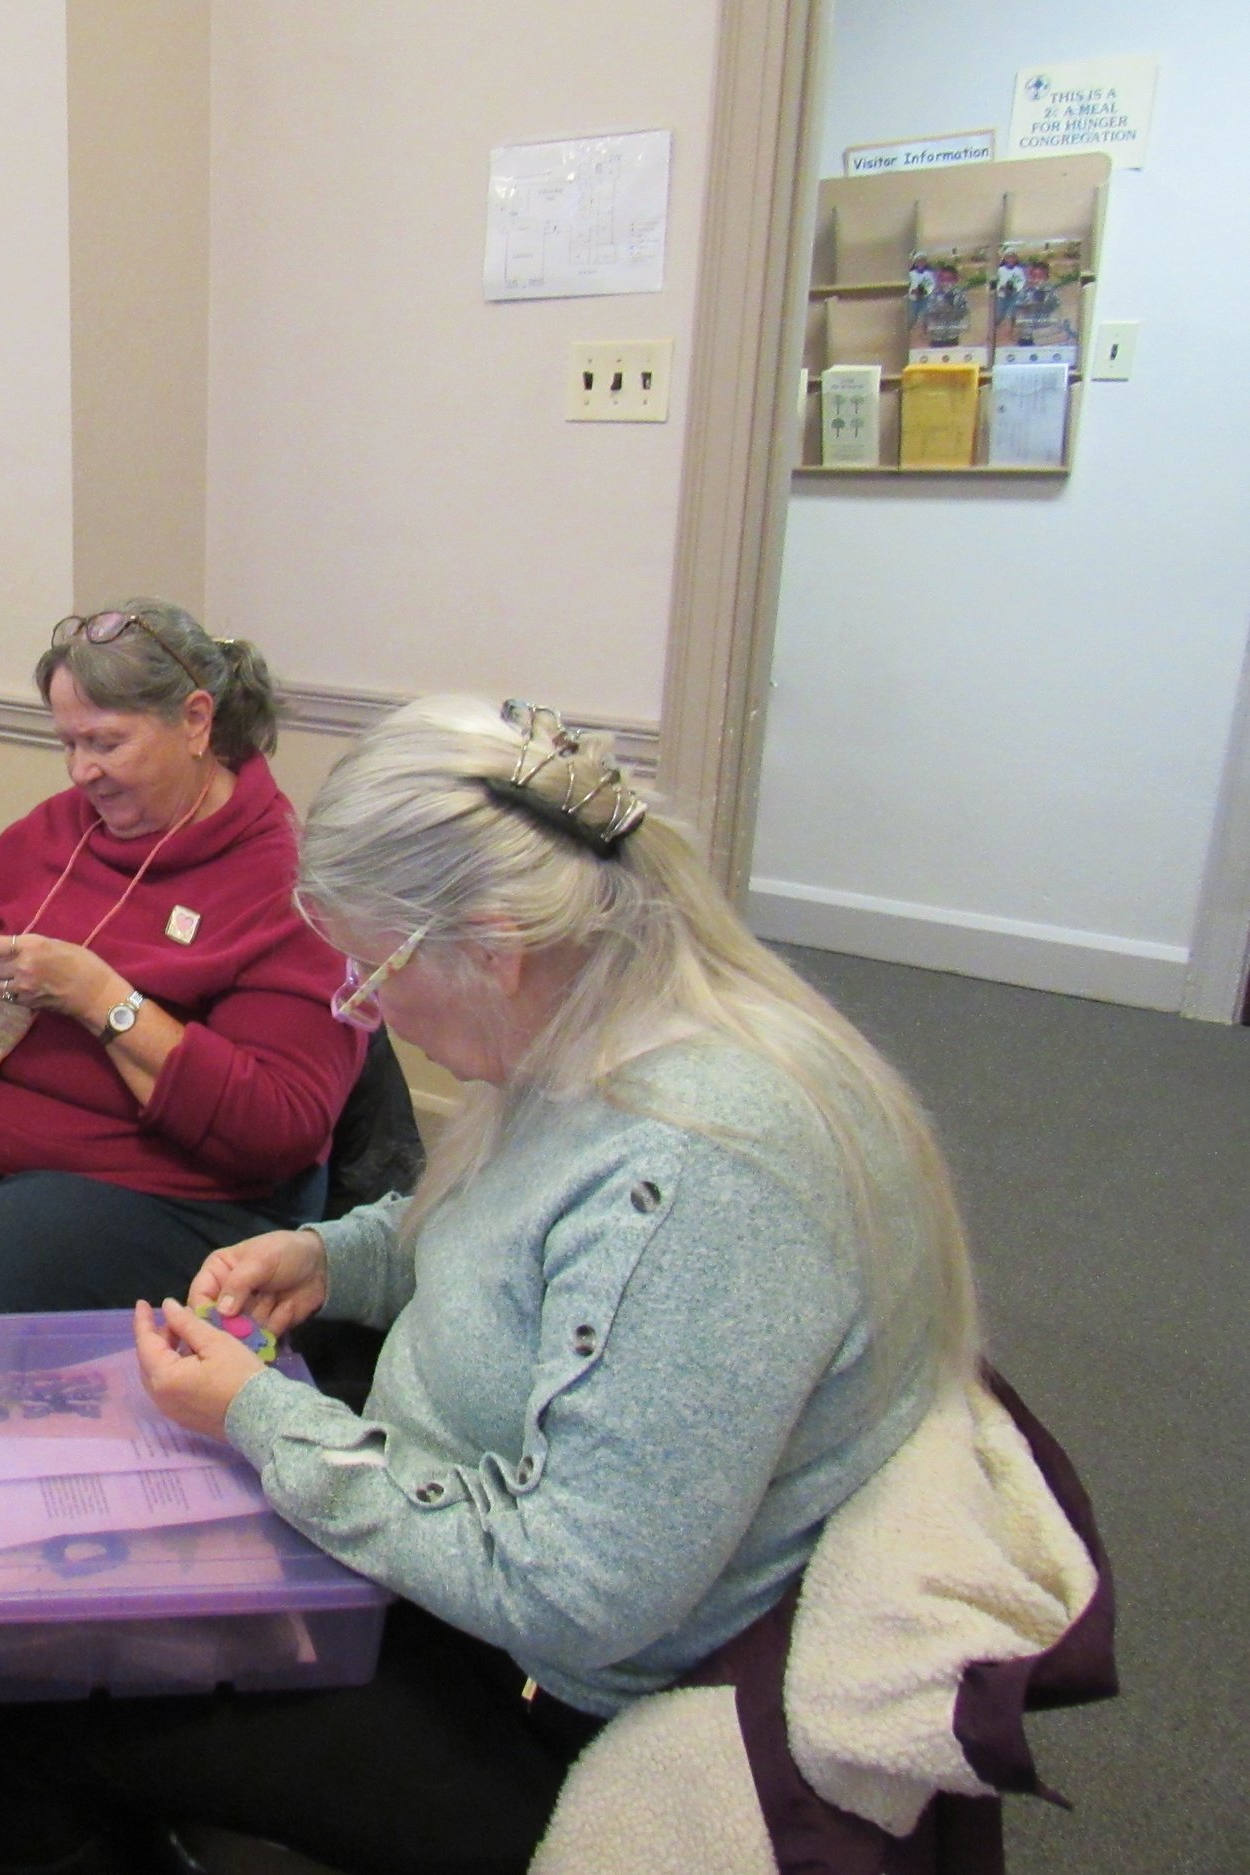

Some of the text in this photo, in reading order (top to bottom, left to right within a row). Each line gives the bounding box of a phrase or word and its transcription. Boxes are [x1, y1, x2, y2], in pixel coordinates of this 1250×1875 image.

[1051, 88, 1118, 104] THIS IS A
[1078, 104, 1120, 117] MEAL
[1031, 115, 1128, 133] FOR HUNGER
[1019, 129, 1137, 149] CONGREGATION
[853, 146, 991, 171] Visitor Information
